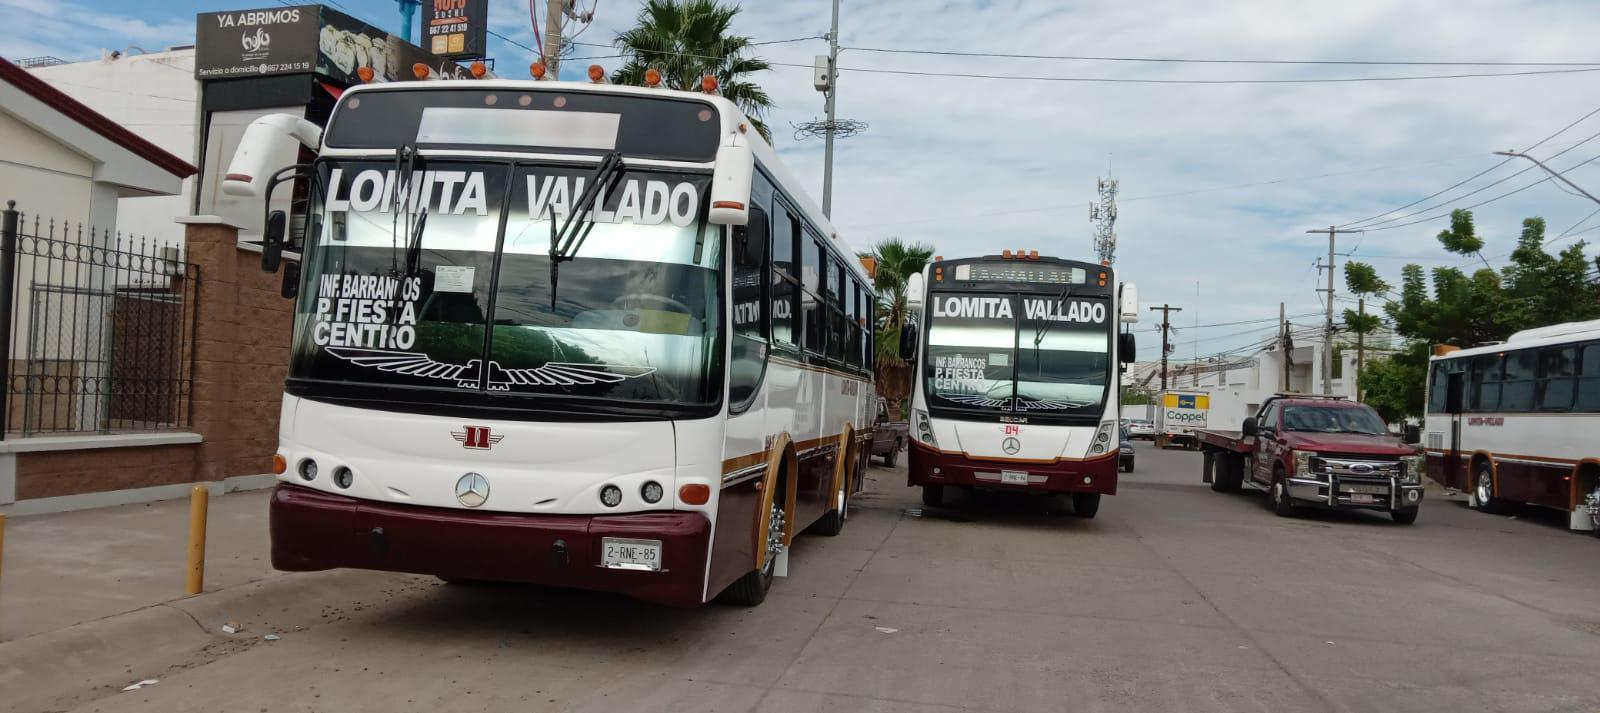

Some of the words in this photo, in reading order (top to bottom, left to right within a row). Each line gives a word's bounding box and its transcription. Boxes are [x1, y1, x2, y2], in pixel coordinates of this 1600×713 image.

[217, 13, 235, 28] YA
[238, 9, 300, 26] ABRIMOS
[434, 9, 464, 19] SUSHI
[199, 68, 224, 76] Servicio
[230, 65, 258, 74] domicilio
[325, 168, 489, 216] LOMITA
[526, 174, 698, 227] VALLADO
[319, 273, 341, 298] INF.
[315, 298, 331, 321] P.
[933, 296, 1014, 319] LOMITA
[1023, 298, 1106, 324] VALLADO
[313, 322, 416, 350] CENTRO
[935, 356, 947, 368] INF.
[947, 356, 986, 369] BARRANCOS
[935, 367, 944, 379] P.
[945, 367, 985, 380] FIESTA
[934, 378, 985, 392] CENTRO
[1167, 410, 1206, 423] Coppel
[464, 426, 490, 449] 11
[1005, 425, 1019, 435] 04
[607, 546, 656, 561] 2-RNE-85
